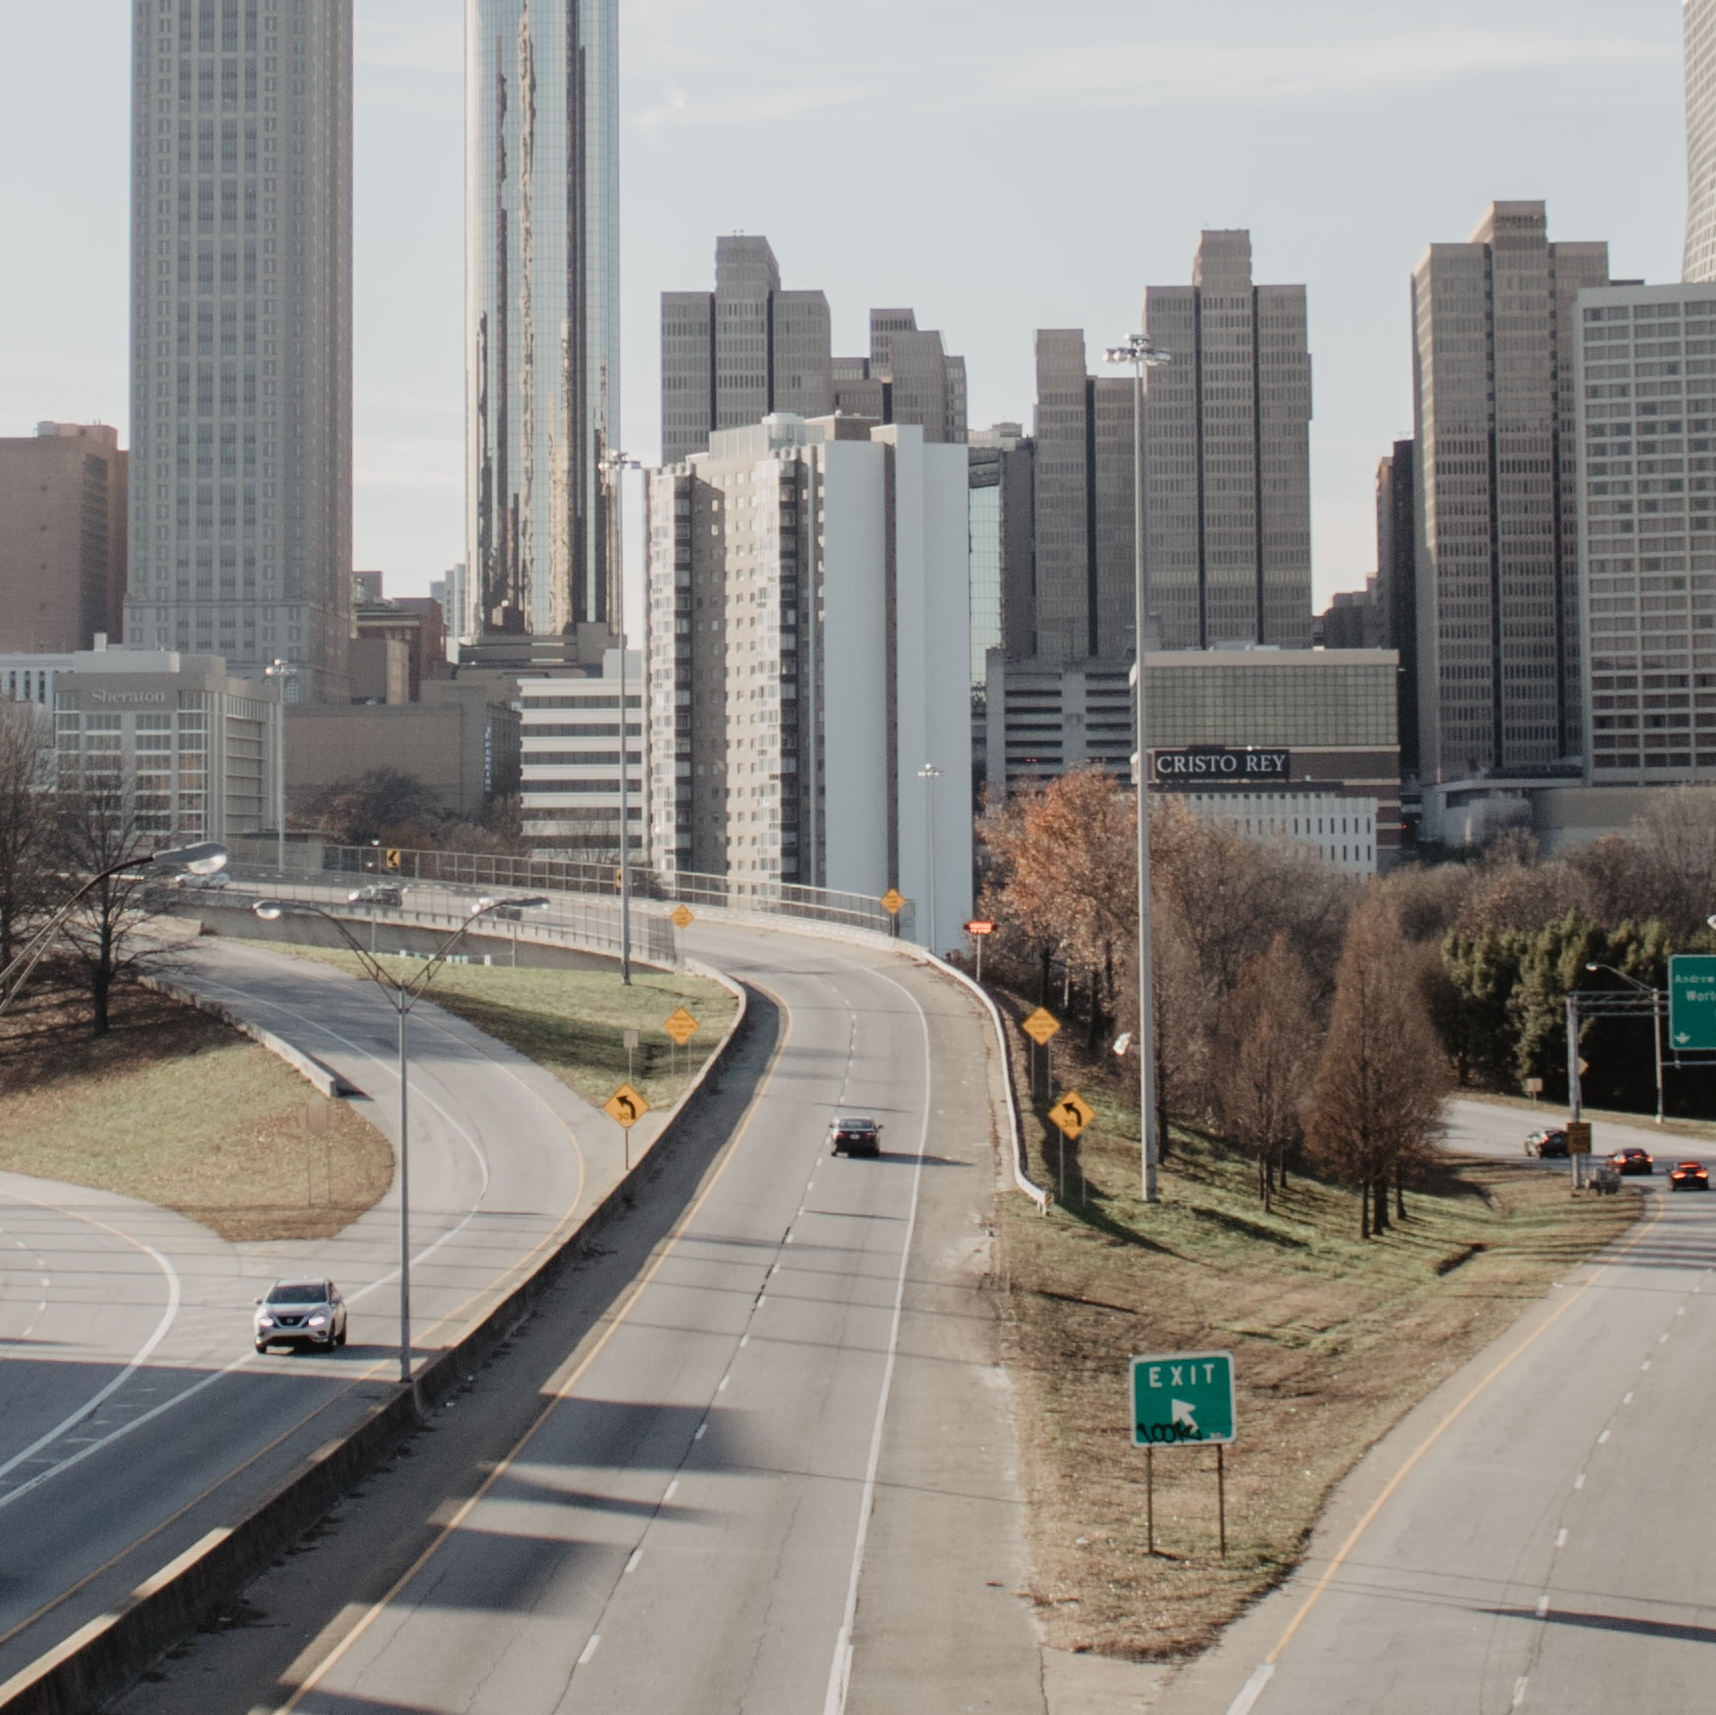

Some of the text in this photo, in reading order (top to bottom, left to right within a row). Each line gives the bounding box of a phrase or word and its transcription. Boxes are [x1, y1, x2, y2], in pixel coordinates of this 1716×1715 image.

[92, 689, 165, 702] Sheraton
[1157, 754, 1286, 773] CRISTO REY
[617, 1112, 630, 1121] 30
[1063, 1119, 1075, 1127] 30
[1149, 1364, 1215, 1388] EXIT
